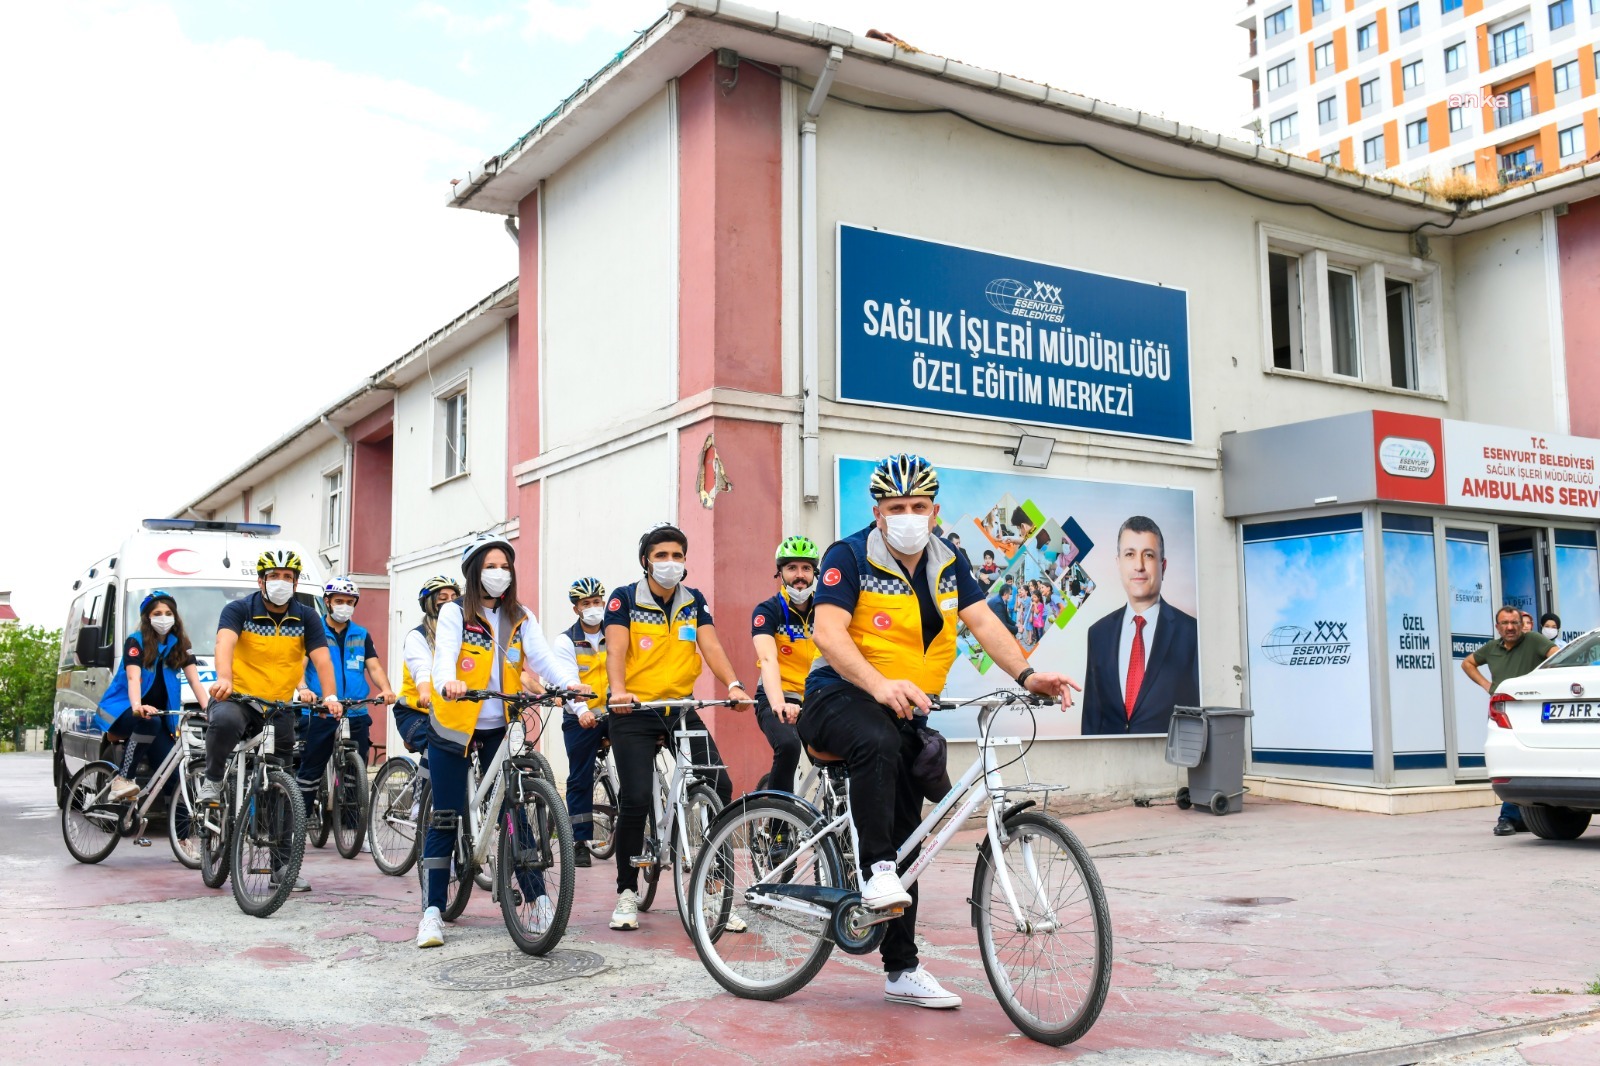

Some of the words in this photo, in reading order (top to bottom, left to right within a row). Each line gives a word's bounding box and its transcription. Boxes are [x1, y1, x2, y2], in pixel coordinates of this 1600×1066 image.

[1014, 298, 1064, 314] ESENYURT
[1011, 307, 1065, 323] BELEDİYESİ
[863, 299, 953, 349] SAĞLIK
[960, 309, 1032, 359] İŞLERİ
[1040, 326, 1171, 381] MÜDÜRLÜĞÜ
[913, 352, 967, 395] ÖZEL
[972, 361, 1042, 405] EĞİTİM
[1048, 376, 1133, 417] MERKEZİ
[1531, 437, 1548, 449] T.C.
[1400, 458, 1429, 466] ESENYURT
[1483, 446, 1537, 464] ESENYURT
[1540, 453, 1595, 471] BELEDİYESİ
[1486, 463, 1516, 477] SAĞLIK
[1518, 465, 1543, 480] İŞLERİ
[1544, 469, 1594, 484] MÜDÜRLÜĞÜ
[1461, 477, 1554, 504] AMBULANS
[1559, 486, 1600, 508] SERV
[1402, 613, 1425, 631] ÖZEL
[1400, 633, 1430, 650] EĞİTİM
[1453, 641, 1465, 654] HOŞ
[1293, 644, 1350, 656] ESENYURT
[1289, 653, 1352, 665] BELEDİYESİ
[1396, 652, 1436, 669] MERKEZİ
[1550, 704, 1565, 717] 27
[1569, 704, 1592, 717] AFR
